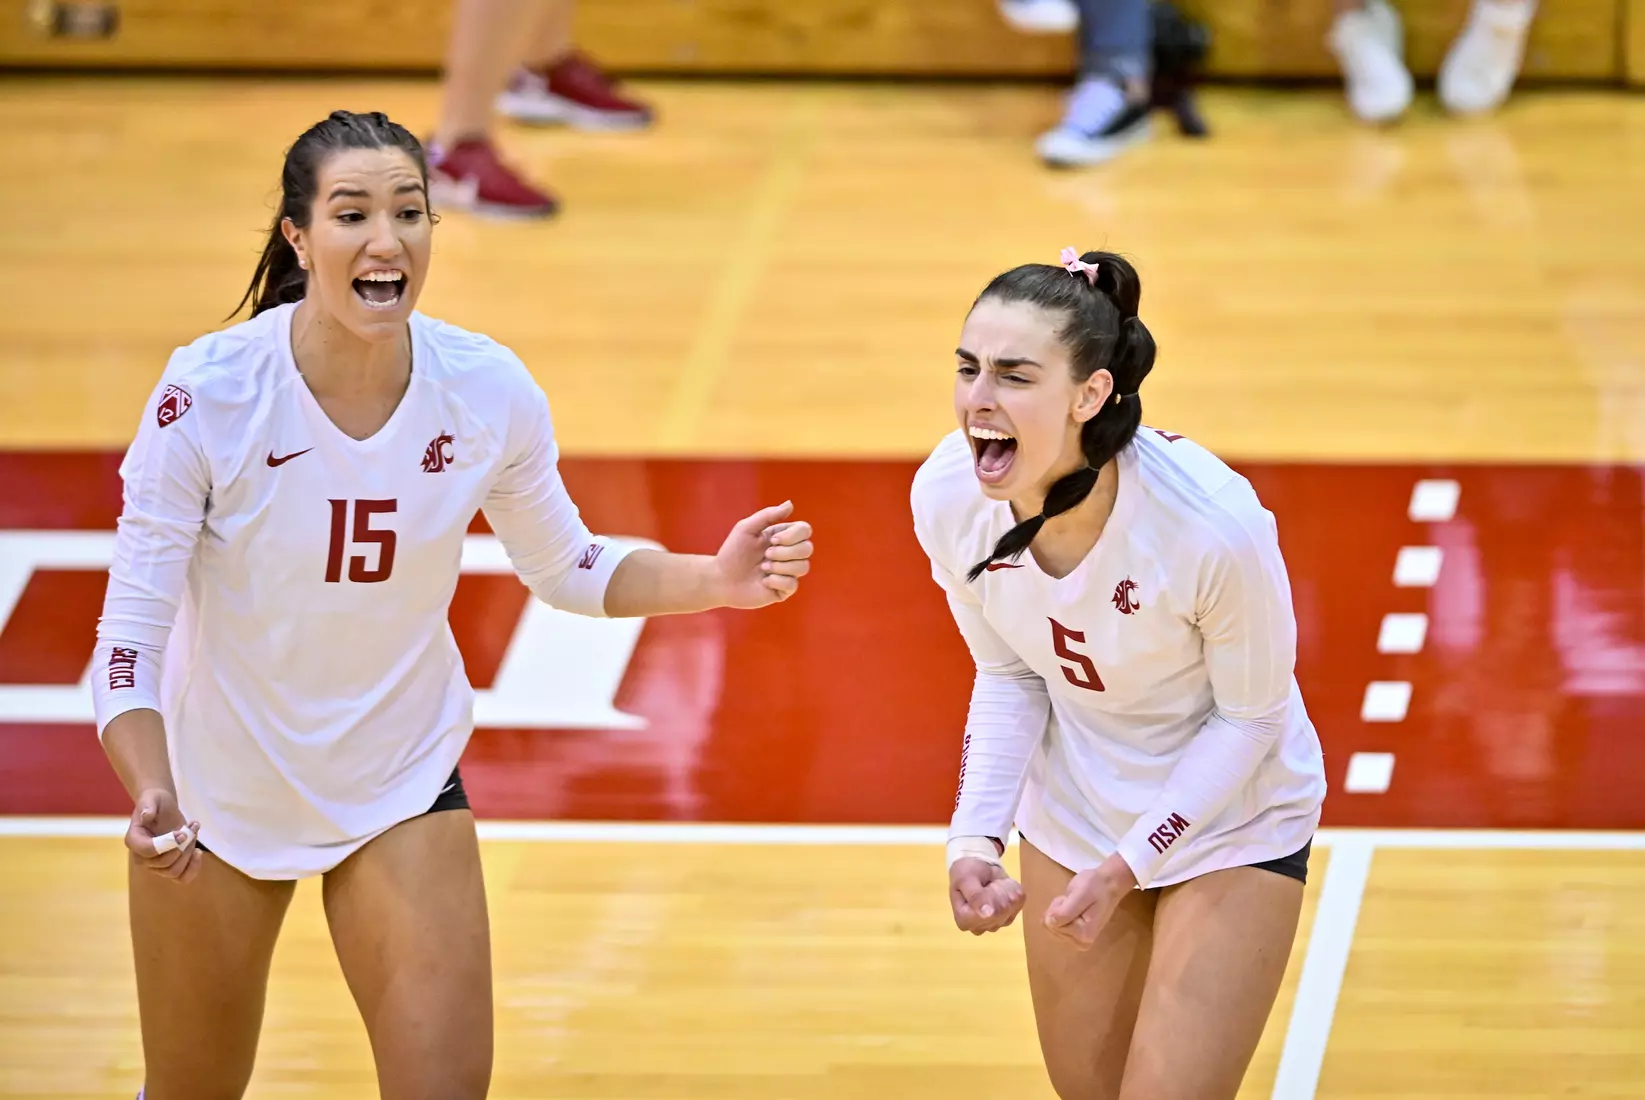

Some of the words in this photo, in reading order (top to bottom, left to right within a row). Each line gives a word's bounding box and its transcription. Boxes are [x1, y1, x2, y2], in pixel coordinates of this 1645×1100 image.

[159, 407, 174, 422] 12
[161, 385, 192, 417] PAC
[325, 498, 397, 583] 15
[578, 543, 605, 570] SU
[1046, 616, 1105, 692] 5
[1147, 811, 1191, 854] WSU
